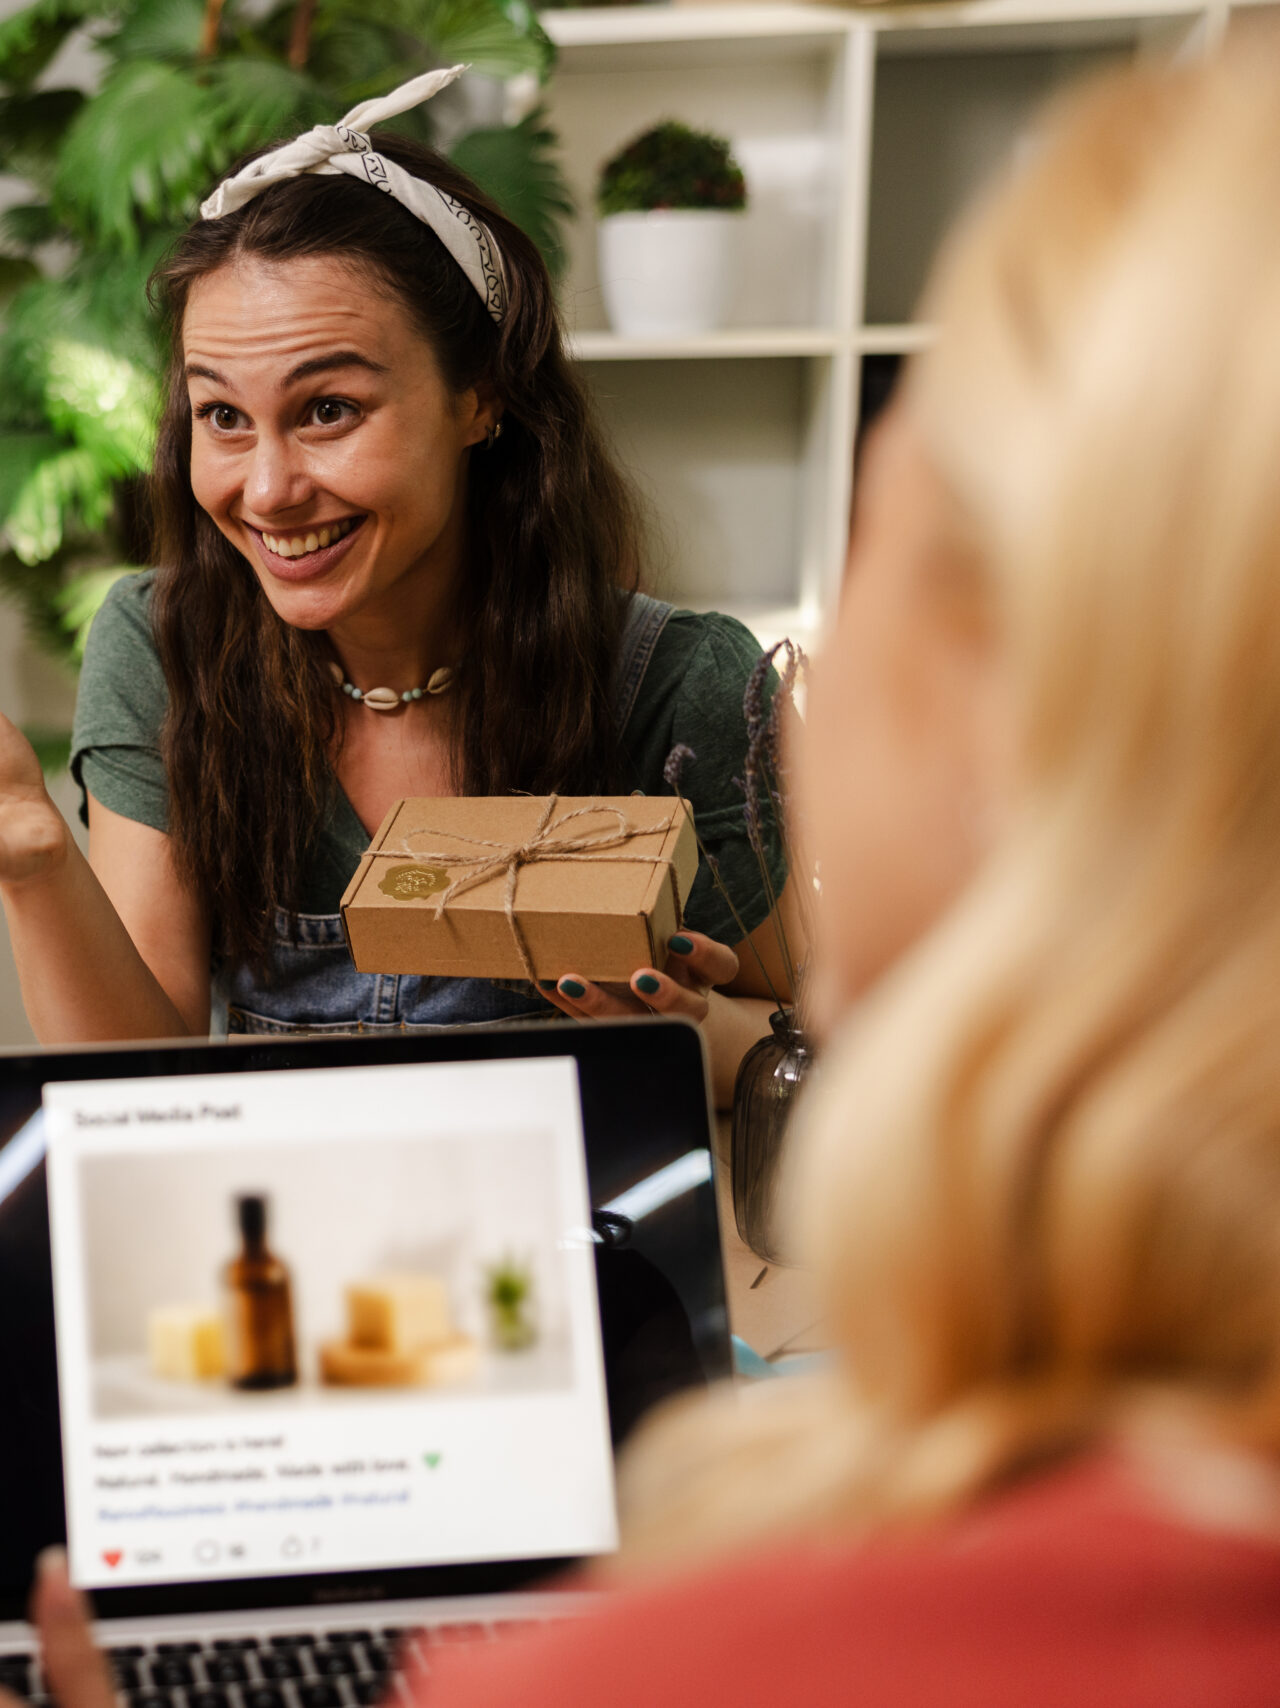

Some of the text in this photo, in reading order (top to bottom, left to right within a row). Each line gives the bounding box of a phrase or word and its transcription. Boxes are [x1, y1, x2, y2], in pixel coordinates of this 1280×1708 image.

[74, 1102, 242, 1128] Social Media Post
